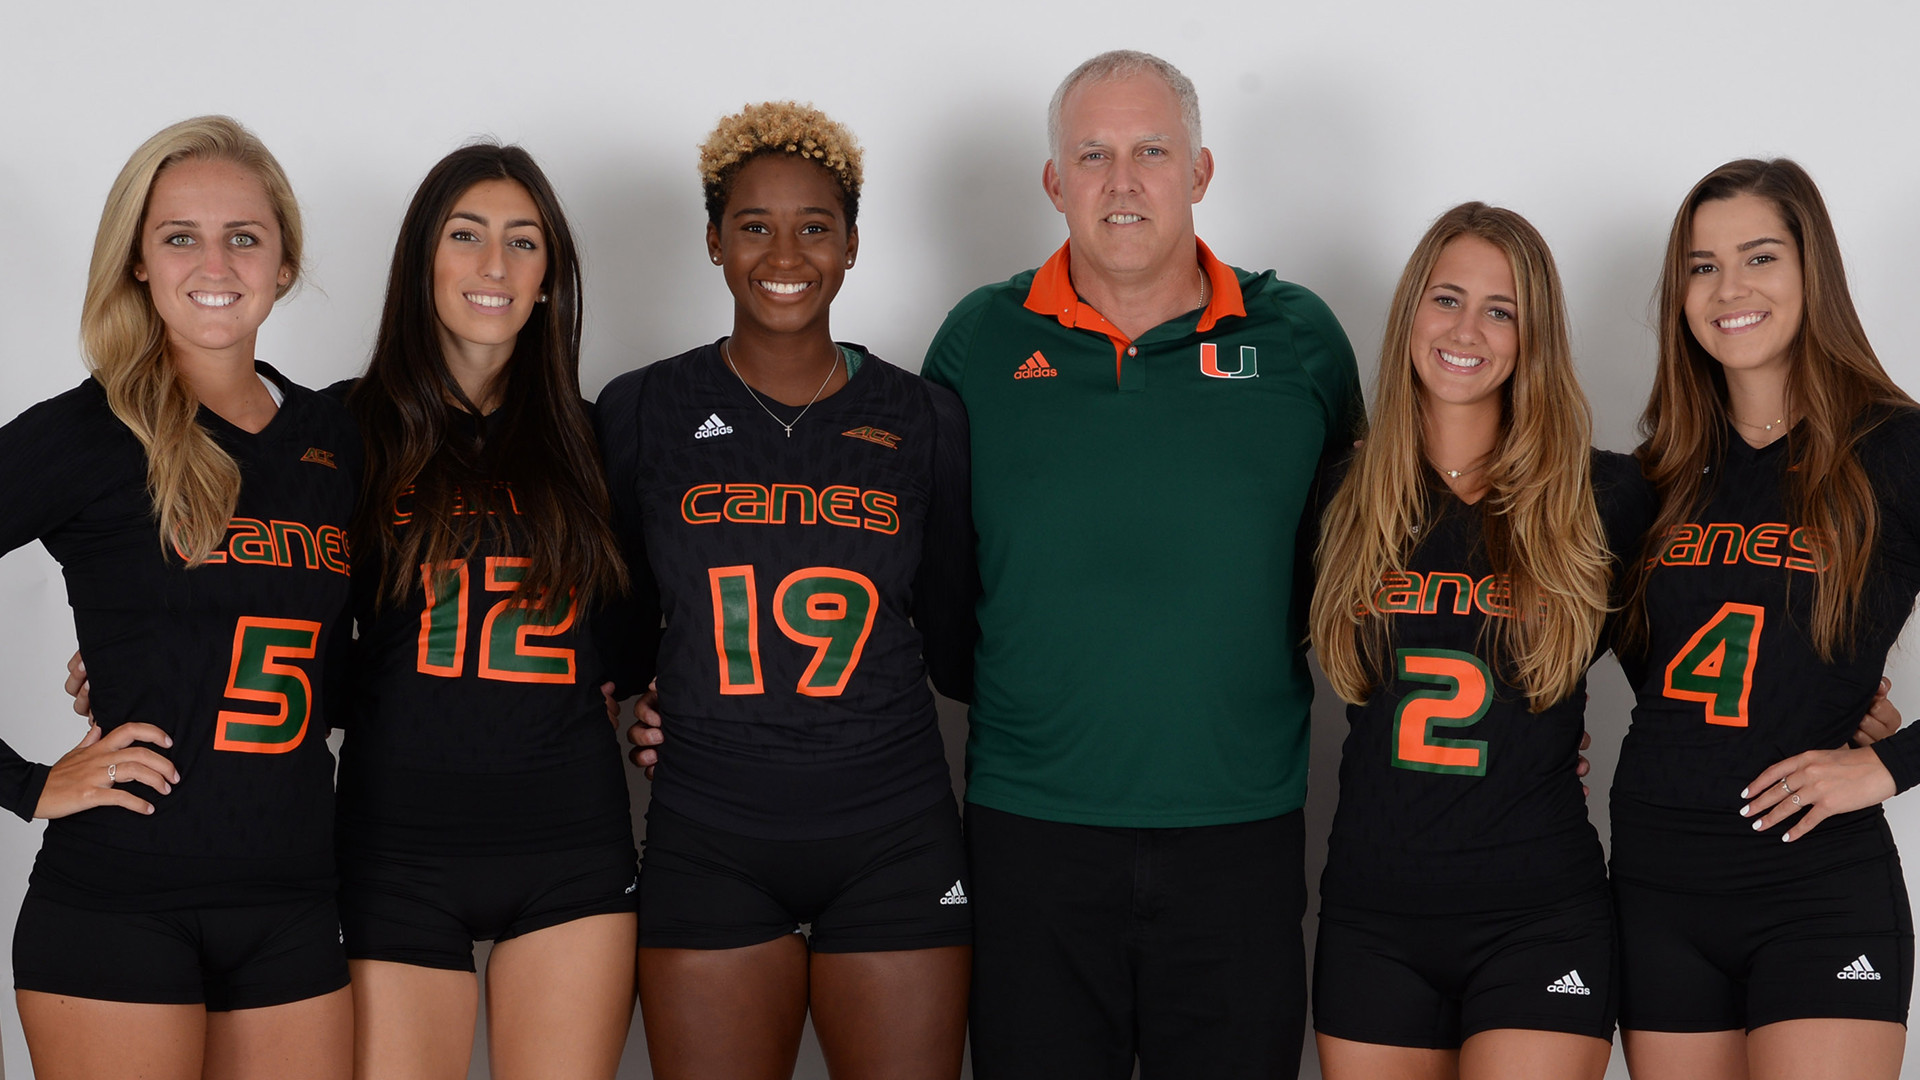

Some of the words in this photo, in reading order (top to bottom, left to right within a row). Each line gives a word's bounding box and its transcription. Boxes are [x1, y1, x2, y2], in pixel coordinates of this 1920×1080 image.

[1013, 367, 1057, 380] adidas
[694, 424, 734, 440] adidas
[854, 425, 901, 447] ACC
[416, 556, 578, 685] 12
[708, 564, 880, 698] 19
[1662, 601, 1765, 728] 4
[213, 616, 322, 755] 5
[1391, 648, 1494, 777] 2
[939, 894, 968, 905] adidas
[1836, 969, 1882, 981] adidas
[1546, 983, 1591, 996] adidas
